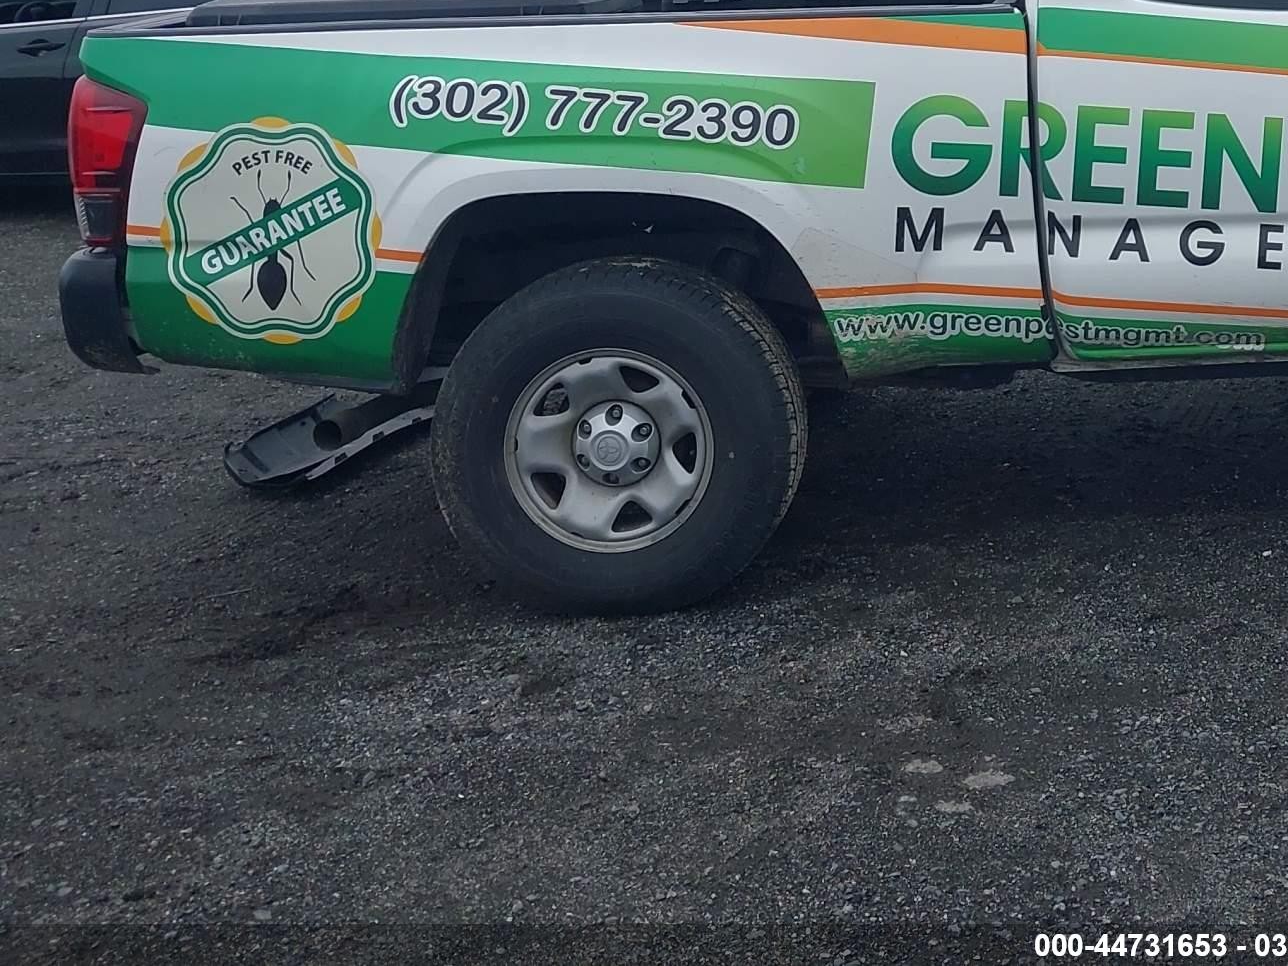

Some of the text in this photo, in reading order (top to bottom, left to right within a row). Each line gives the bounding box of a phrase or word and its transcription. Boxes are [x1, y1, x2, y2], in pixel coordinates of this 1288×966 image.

[392, 76, 797, 147] (302) 777-2390
[231, 150, 313, 175] PEST FREE
[891, 94, 1284, 214] GREEN
[200, 187, 347, 275] GUARANTEE
